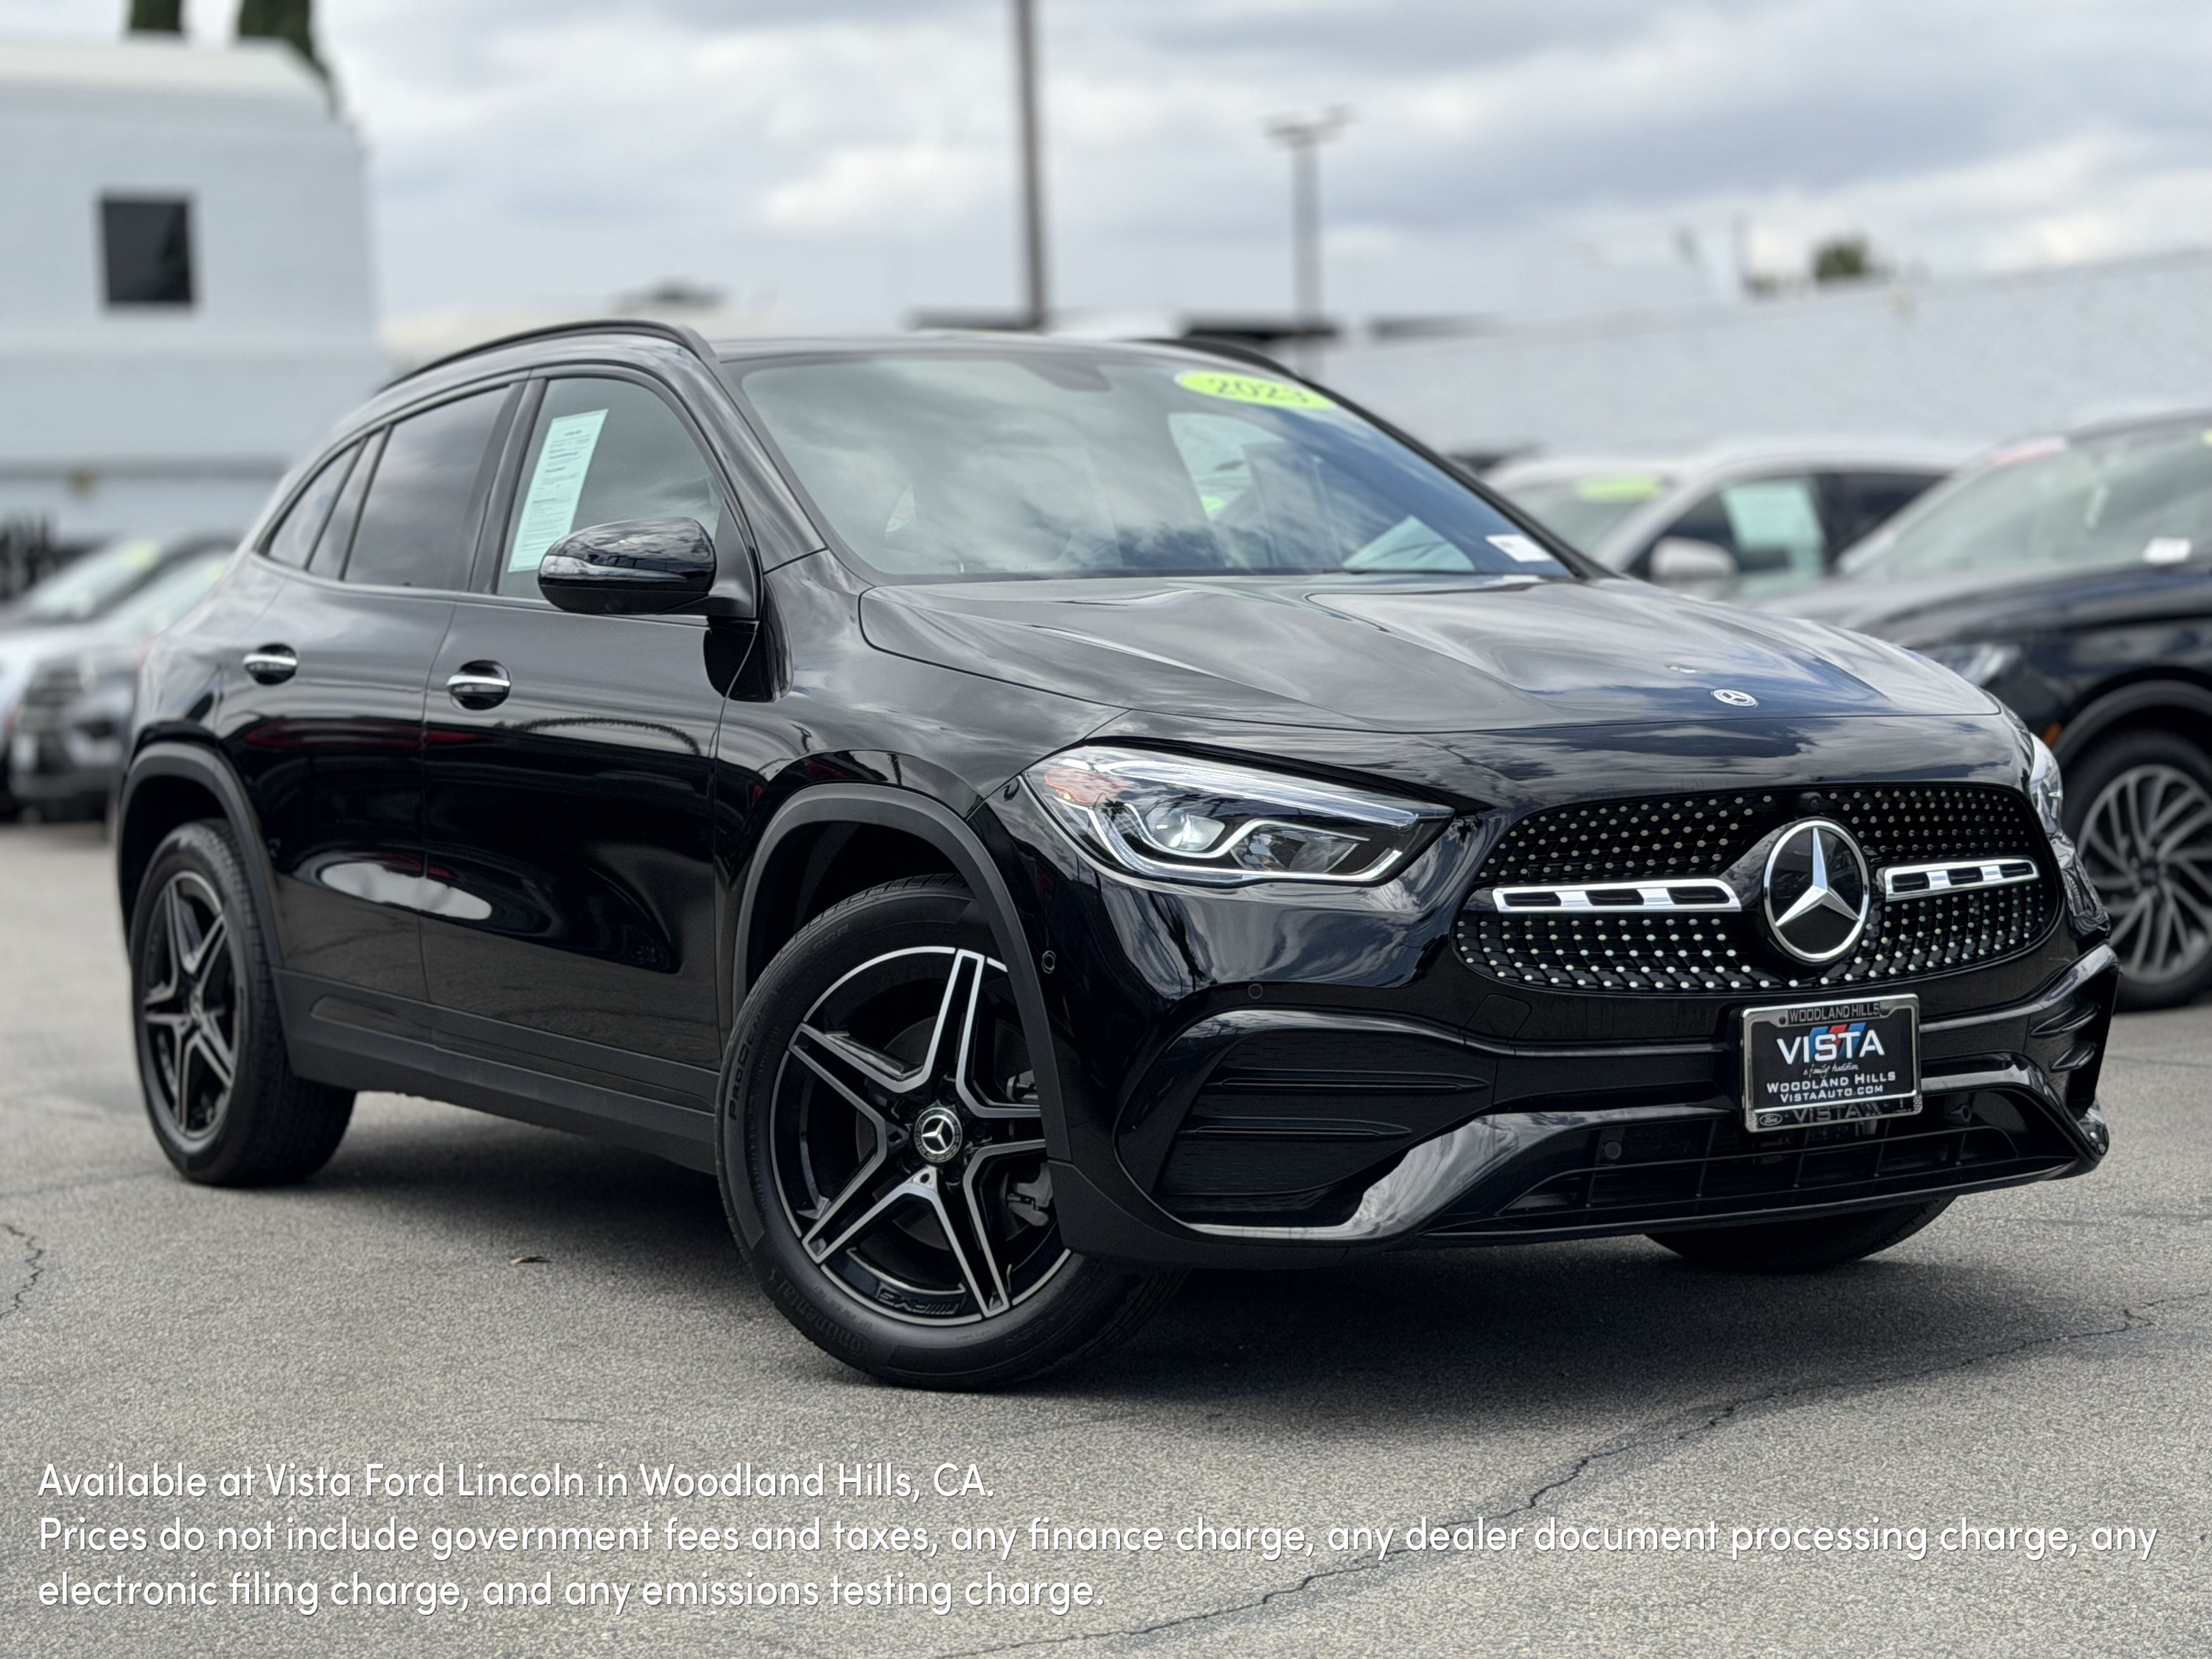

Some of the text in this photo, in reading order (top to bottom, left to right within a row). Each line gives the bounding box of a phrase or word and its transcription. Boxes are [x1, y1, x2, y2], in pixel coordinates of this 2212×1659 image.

[1788, 1002, 1880, 1023] WOODLAND HILLS
[1776, 1029, 1885, 1065] VISTA
[1766, 1071, 1896, 1094] WOODLAND HILLS
[1792, 1103, 1862, 1124] VISTA
